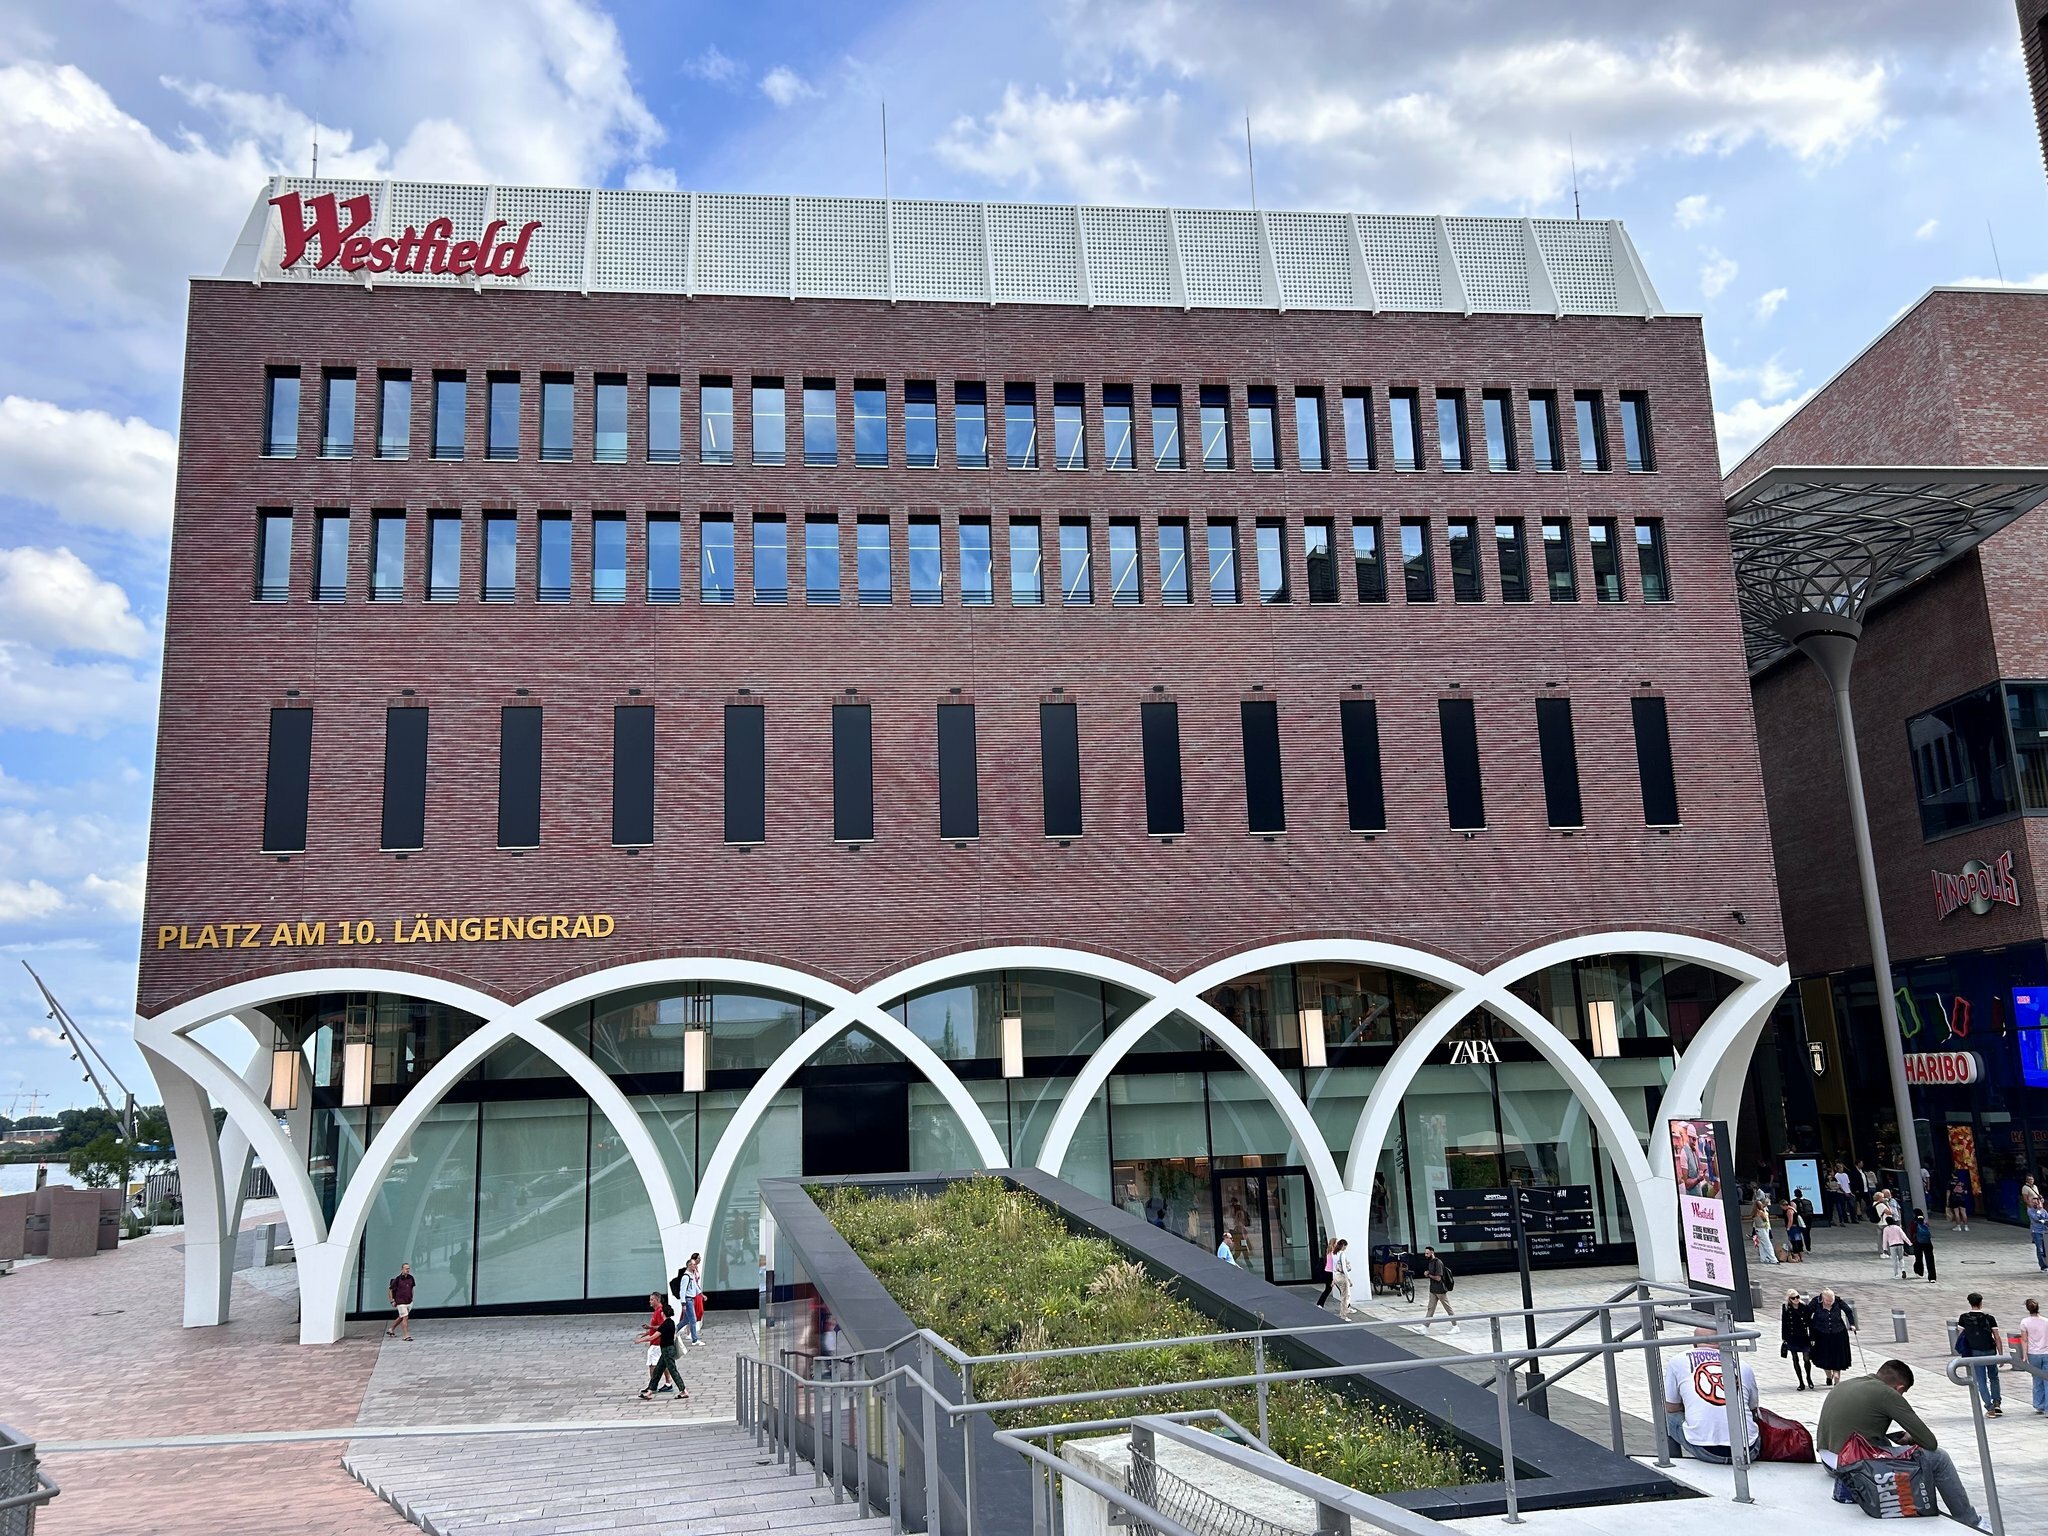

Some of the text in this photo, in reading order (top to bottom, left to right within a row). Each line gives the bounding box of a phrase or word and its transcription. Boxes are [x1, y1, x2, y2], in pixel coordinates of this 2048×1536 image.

[268, 191, 543, 277] Westfield
[1931, 850, 2020, 920] KINOPOLIS
[157, 913, 615, 950] PLATZ AM 10. LÄNGENGRAD
[1448, 1040, 1502, 1065] ZARA
[1904, 1054, 1969, 1082] HARIBO
[1691, 1202, 1715, 1220] Westfield
